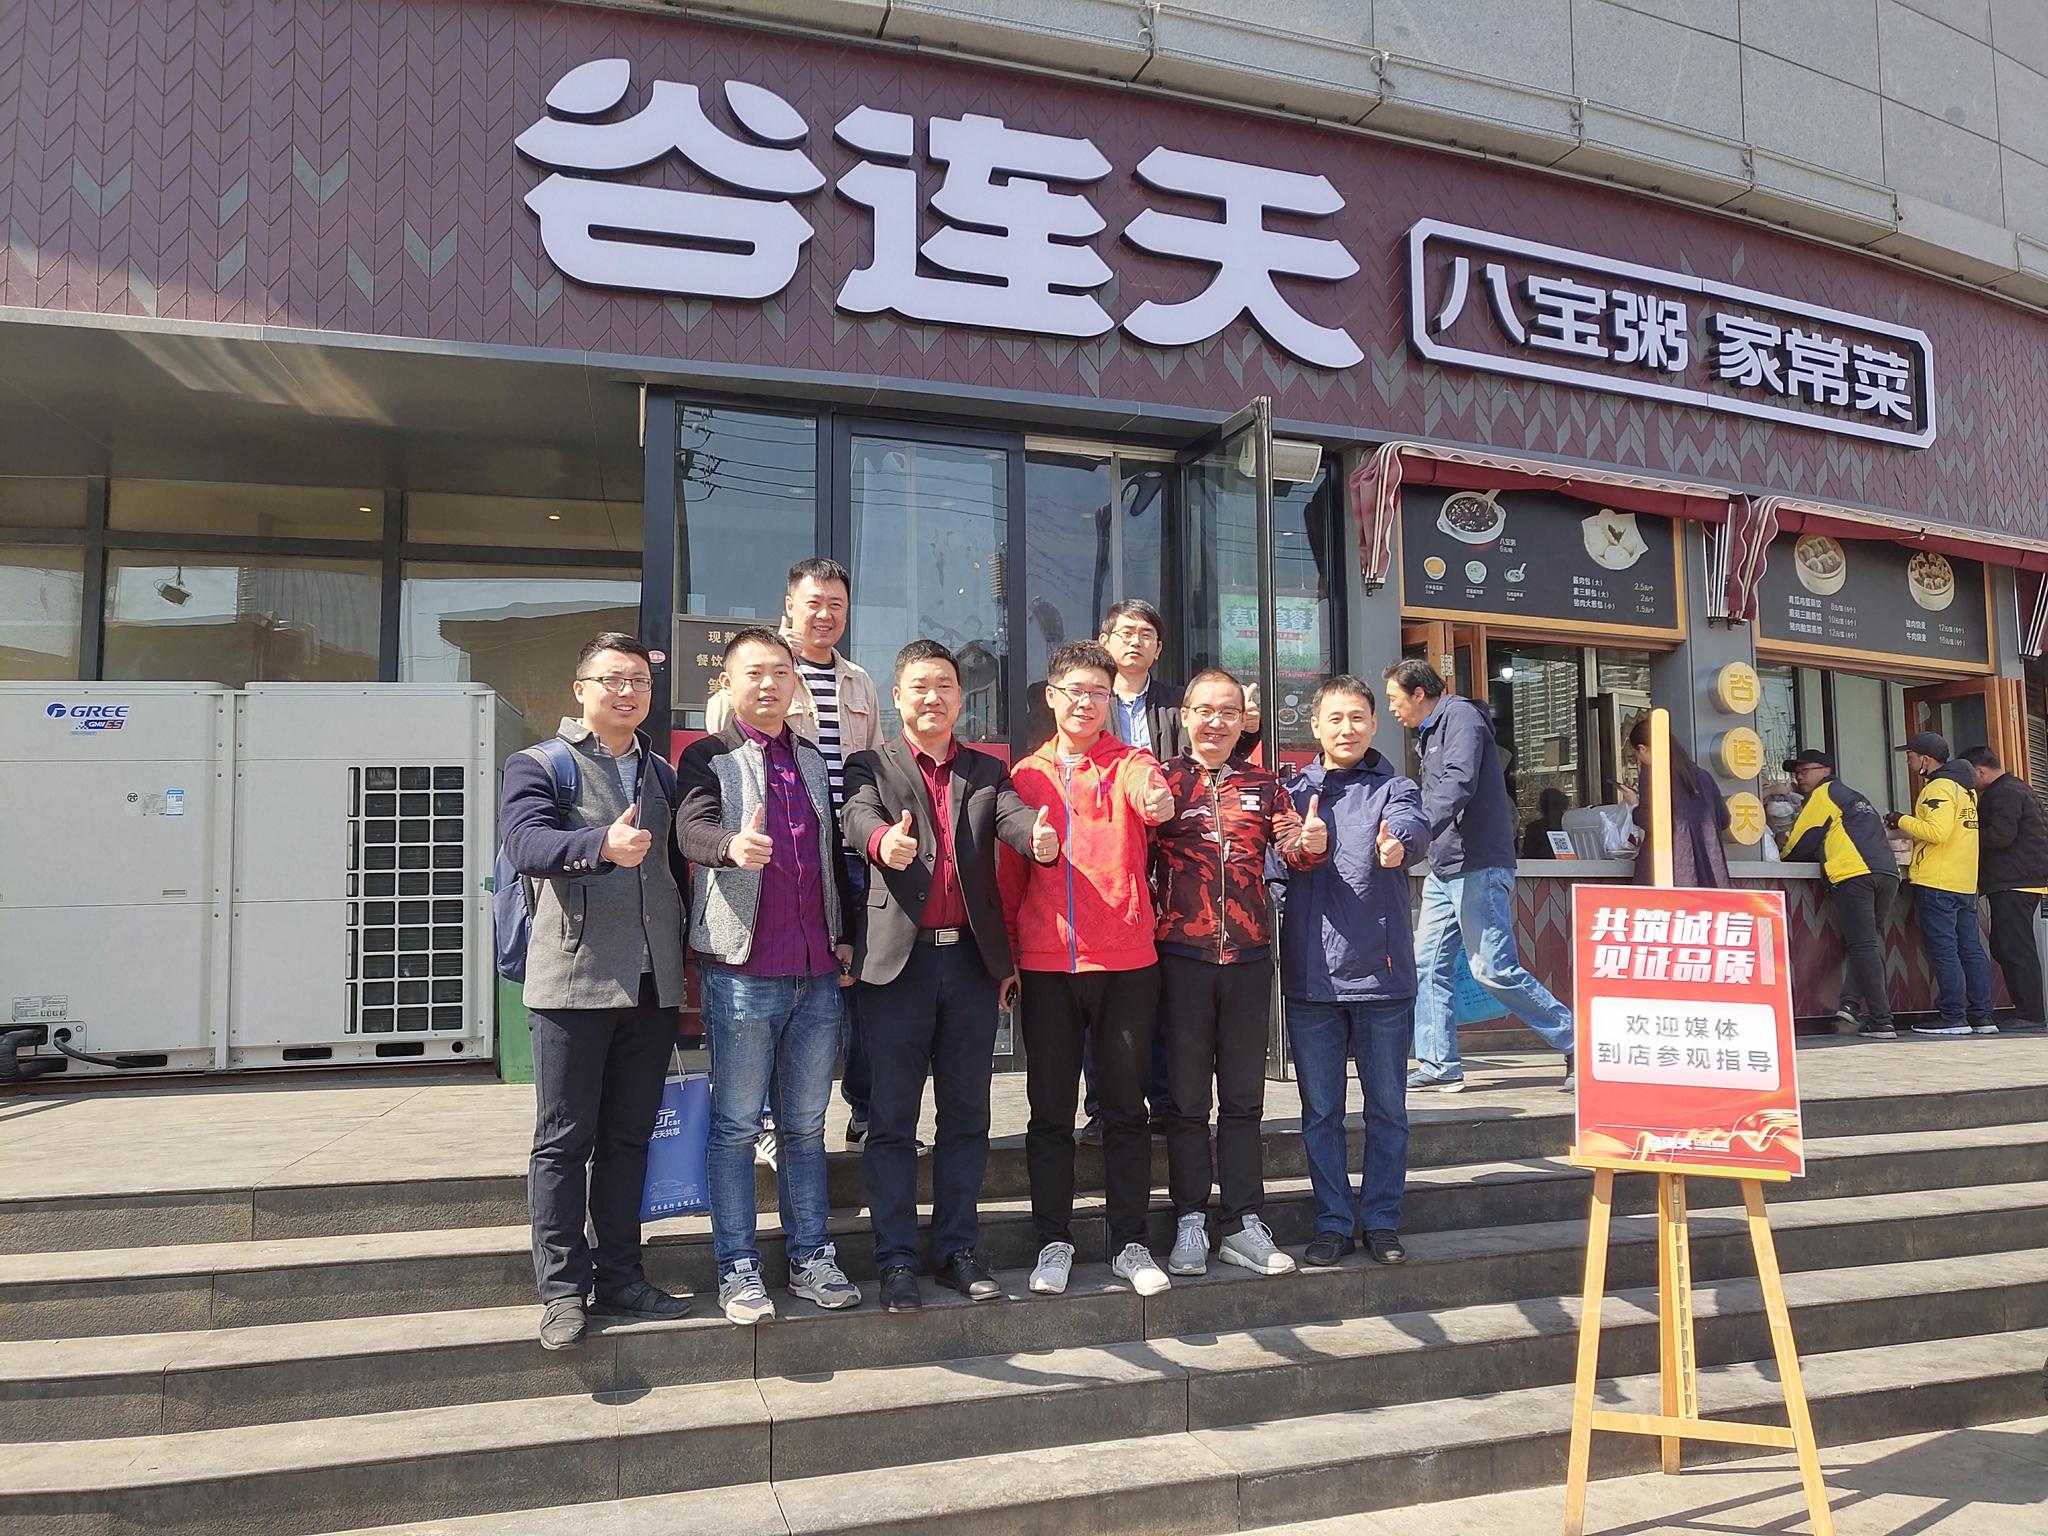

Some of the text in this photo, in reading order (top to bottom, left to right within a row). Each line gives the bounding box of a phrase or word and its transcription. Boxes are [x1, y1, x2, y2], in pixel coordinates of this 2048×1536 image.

[515, 57, 1364, 369] 谷连天
[1437, 256, 1912, 421] 八宝粥 家常菜
[696, 654, 723, 667] 餐饮
[70, 705, 130, 718] GREE
[1590, 907, 1755, 947] 共筑诚信
[1591, 944, 1756, 985] 见证品质
[1626, 1014, 1739, 1041] 欢迎媒体
[1598, 1042, 1772, 1073] 到店参观指导
